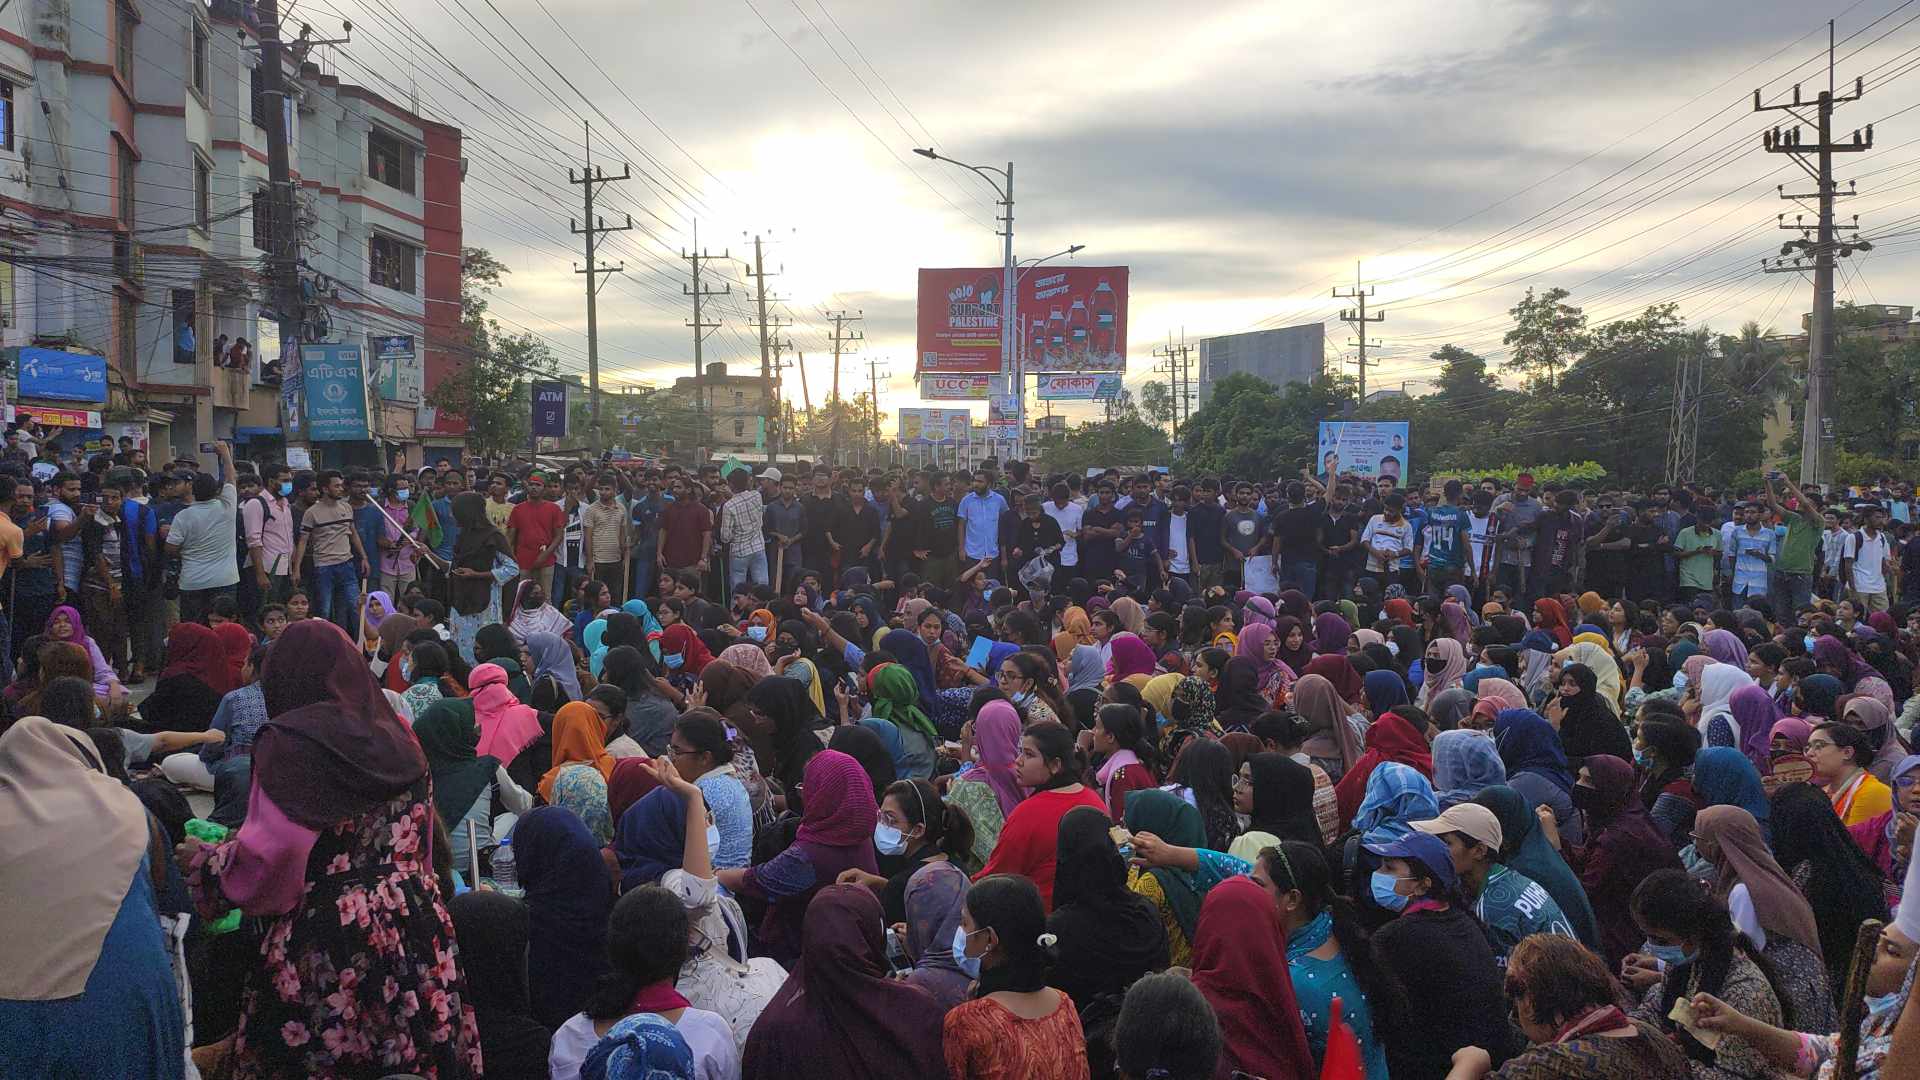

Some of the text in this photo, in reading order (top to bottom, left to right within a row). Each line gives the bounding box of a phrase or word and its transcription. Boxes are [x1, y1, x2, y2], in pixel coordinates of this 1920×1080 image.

[950, 303, 1000, 316] SUPPORT
[950, 316, 999, 328] PALESTINE
[936, 379, 969, 389] UCC
[538, 391, 563, 402] ATM
